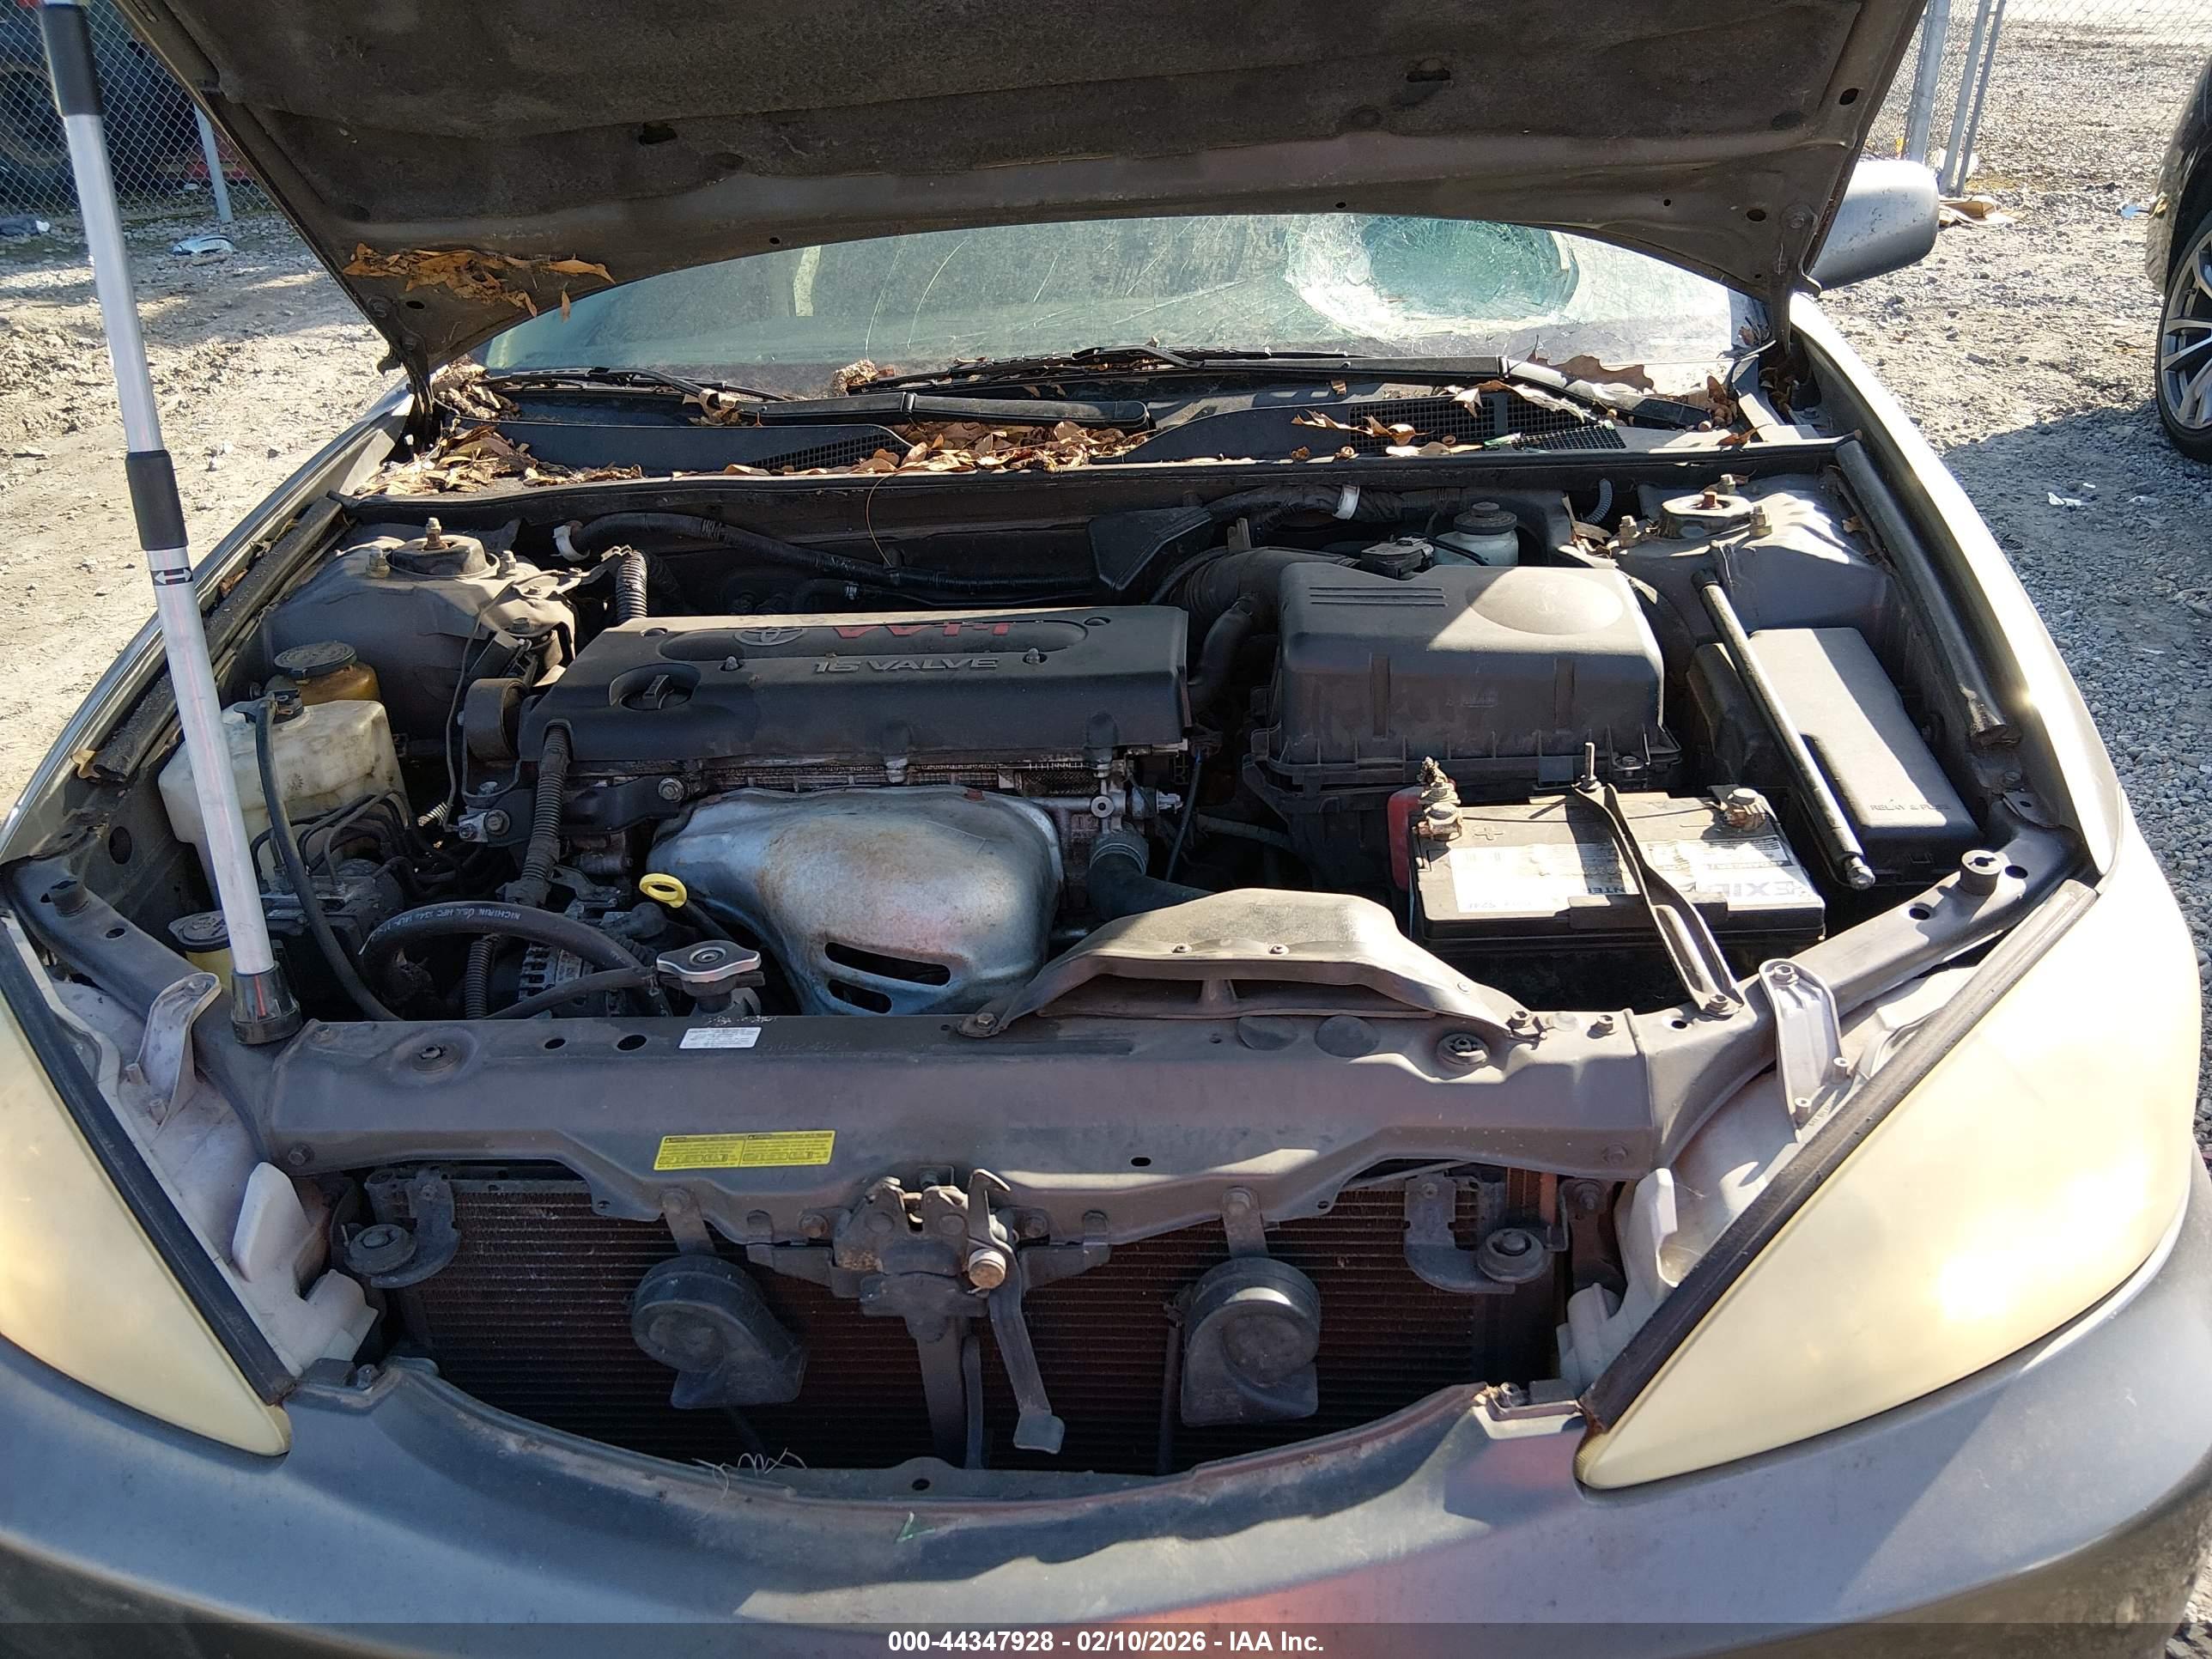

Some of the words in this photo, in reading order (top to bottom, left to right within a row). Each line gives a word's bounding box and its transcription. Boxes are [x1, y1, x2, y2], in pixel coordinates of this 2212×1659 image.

[815, 660, 861, 673] 16
[867, 657, 999, 671] VALVE
[479, 908, 522, 921] NICHIRIN
